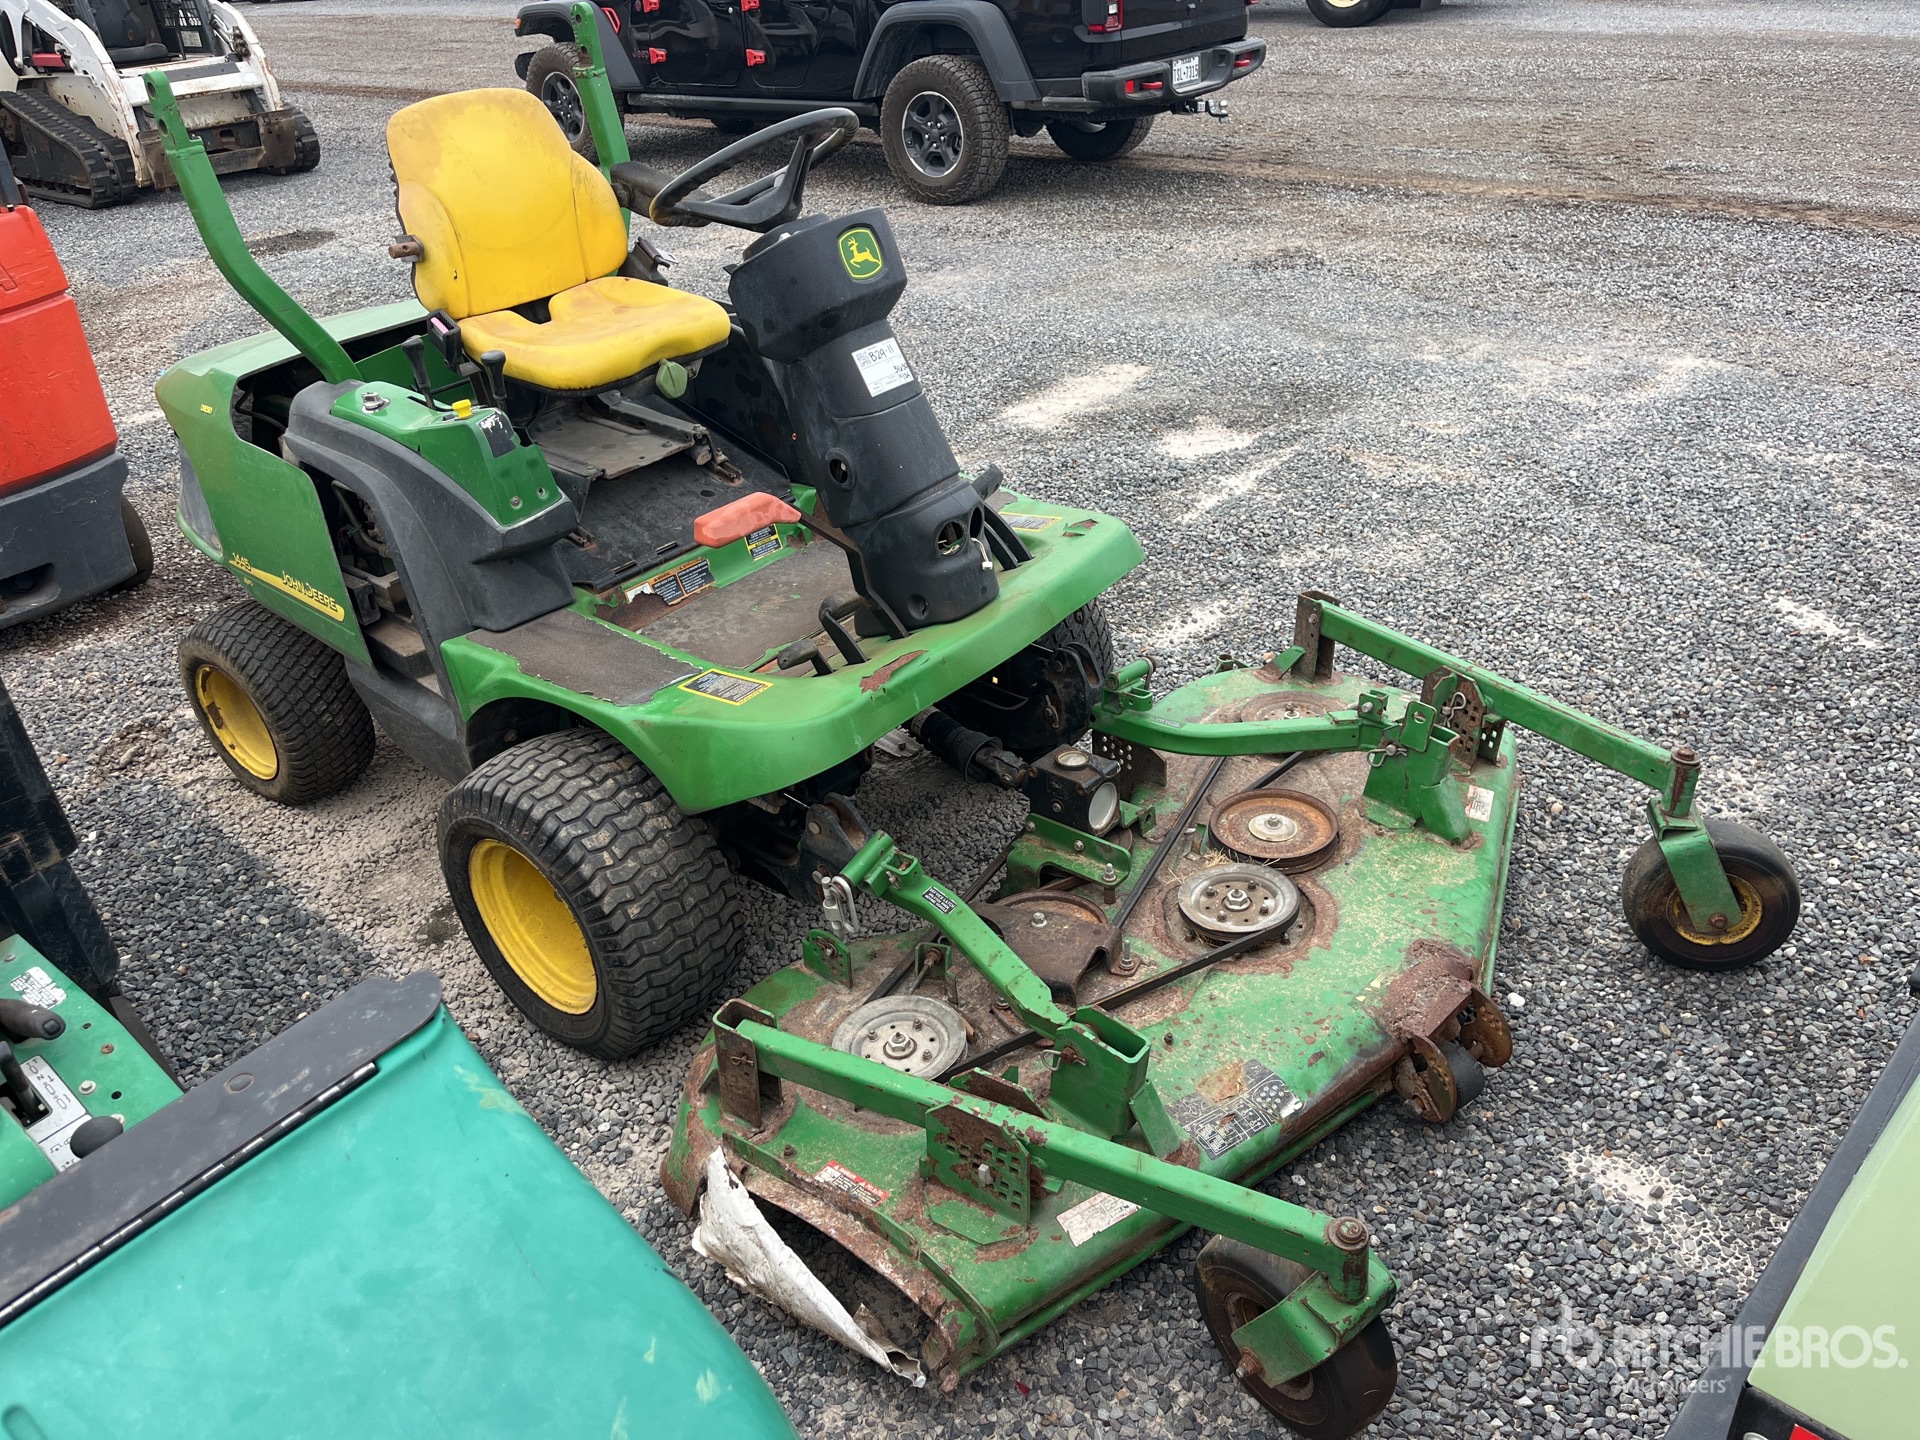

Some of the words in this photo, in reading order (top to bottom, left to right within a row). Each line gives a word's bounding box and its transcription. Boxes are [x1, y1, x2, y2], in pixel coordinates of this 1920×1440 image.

[868, 344, 895, 362] B29-11
[282, 570, 305, 594] JOHN
[304, 582, 338, 612] DEERE
